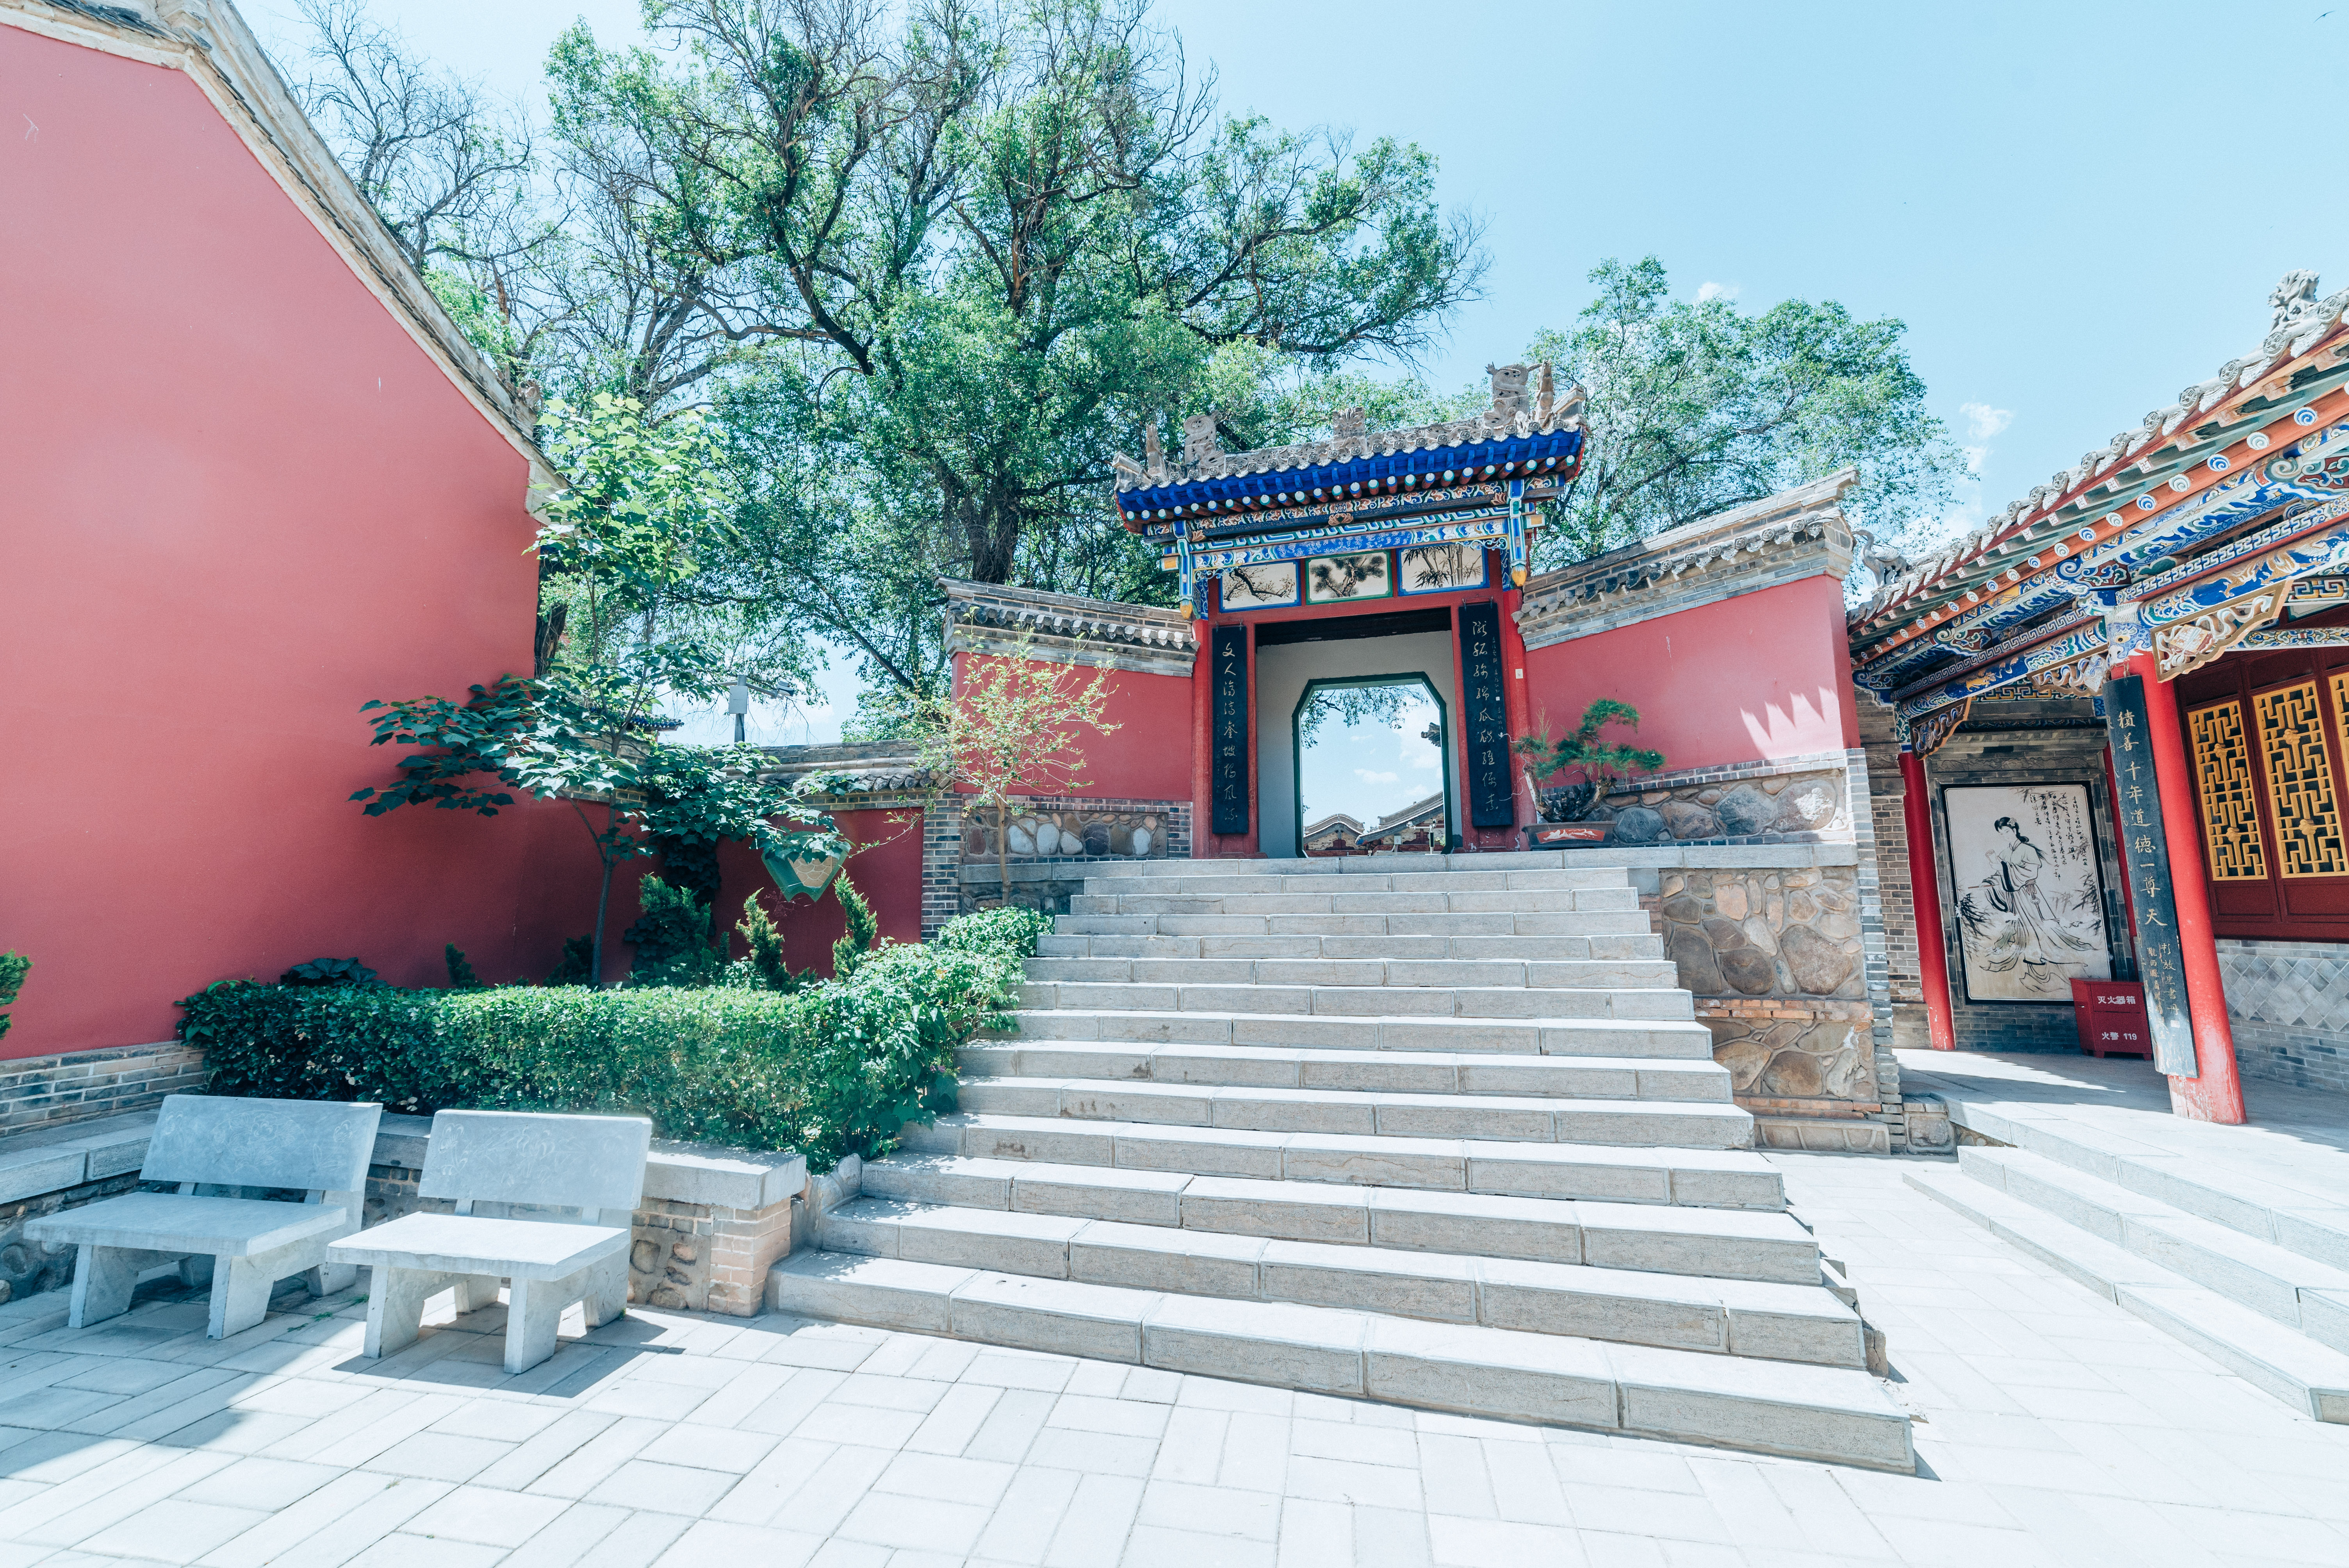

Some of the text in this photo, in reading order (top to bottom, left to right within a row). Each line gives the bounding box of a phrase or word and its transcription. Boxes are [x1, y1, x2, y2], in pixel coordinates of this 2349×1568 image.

[2097, 996, 2136, 1005] 灭火器箱
[2101, 1032, 2119, 1040] 火警
